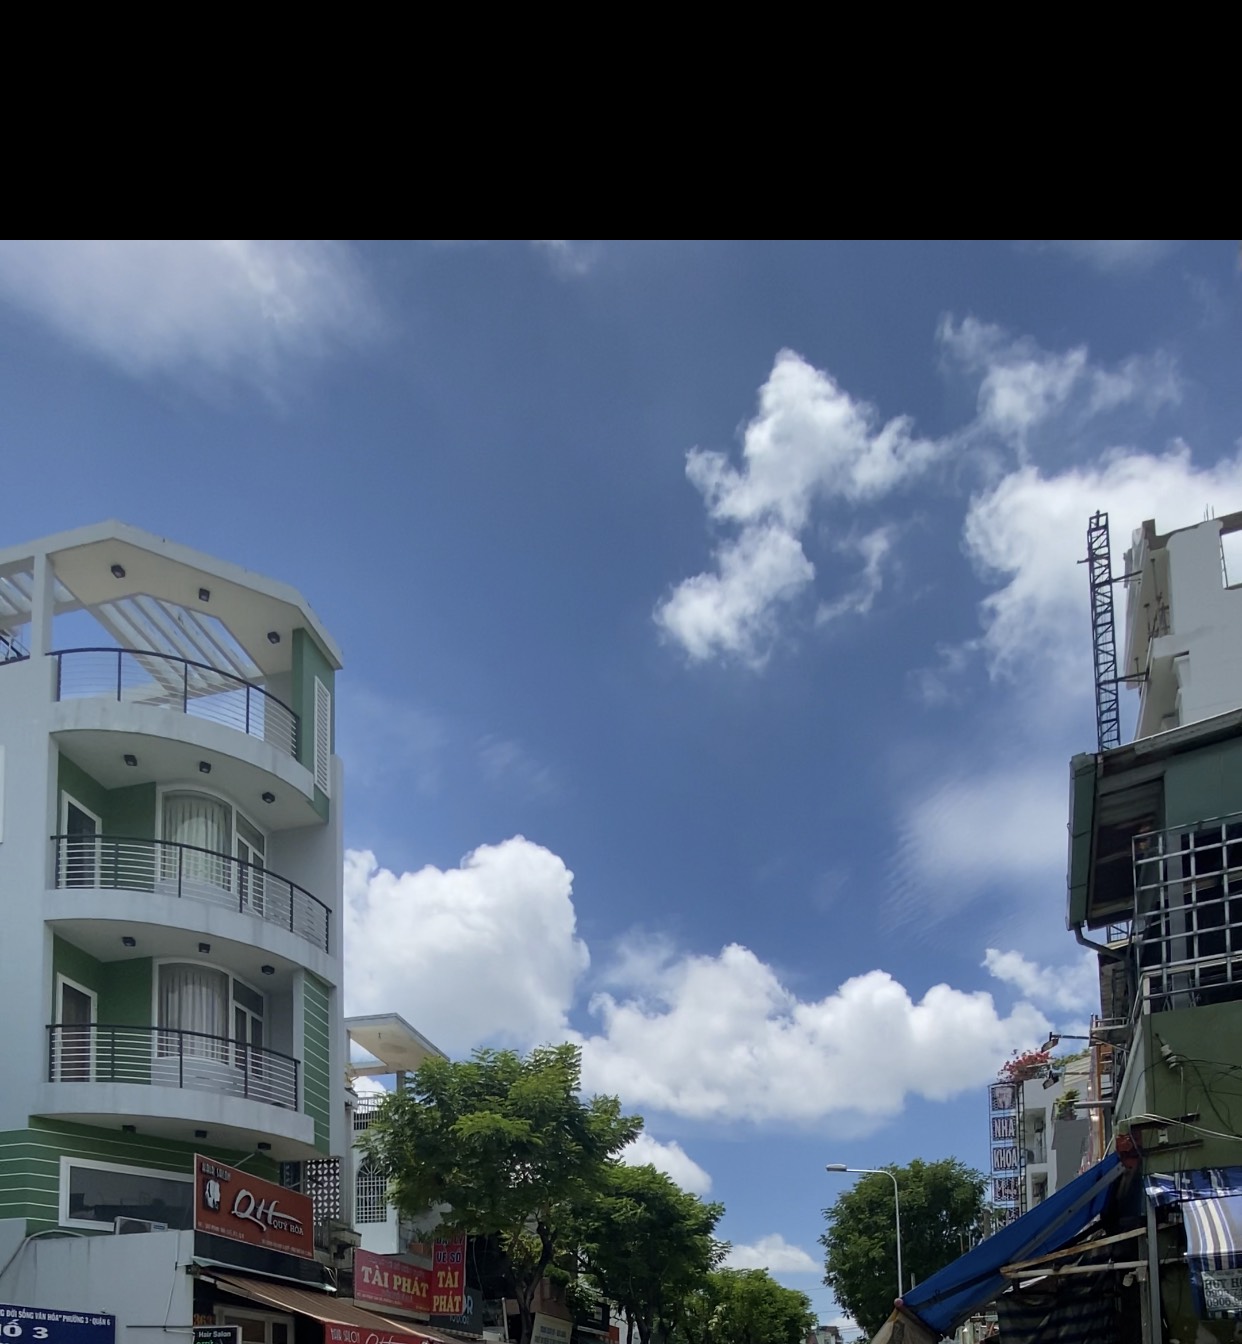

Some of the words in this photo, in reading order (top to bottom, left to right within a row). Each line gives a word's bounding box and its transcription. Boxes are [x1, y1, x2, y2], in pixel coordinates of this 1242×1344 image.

[994, 1118, 1015, 1138] NHA
[993, 1148, 1017, 1169] KHOA
[361, 1265, 389, 1288] TÀI
[392, 1276, 429, 1298] PHÁT
[437, 1266, 460, 1288] TÀI
[432, 1291, 462, 1313] PHÁT
[18, 1308, 34, 1320] SỐNG
[85, 1316, 89, 1324] 3
[32, 1326, 49, 1339] 3
[213, 1330, 231, 1338] Salon
